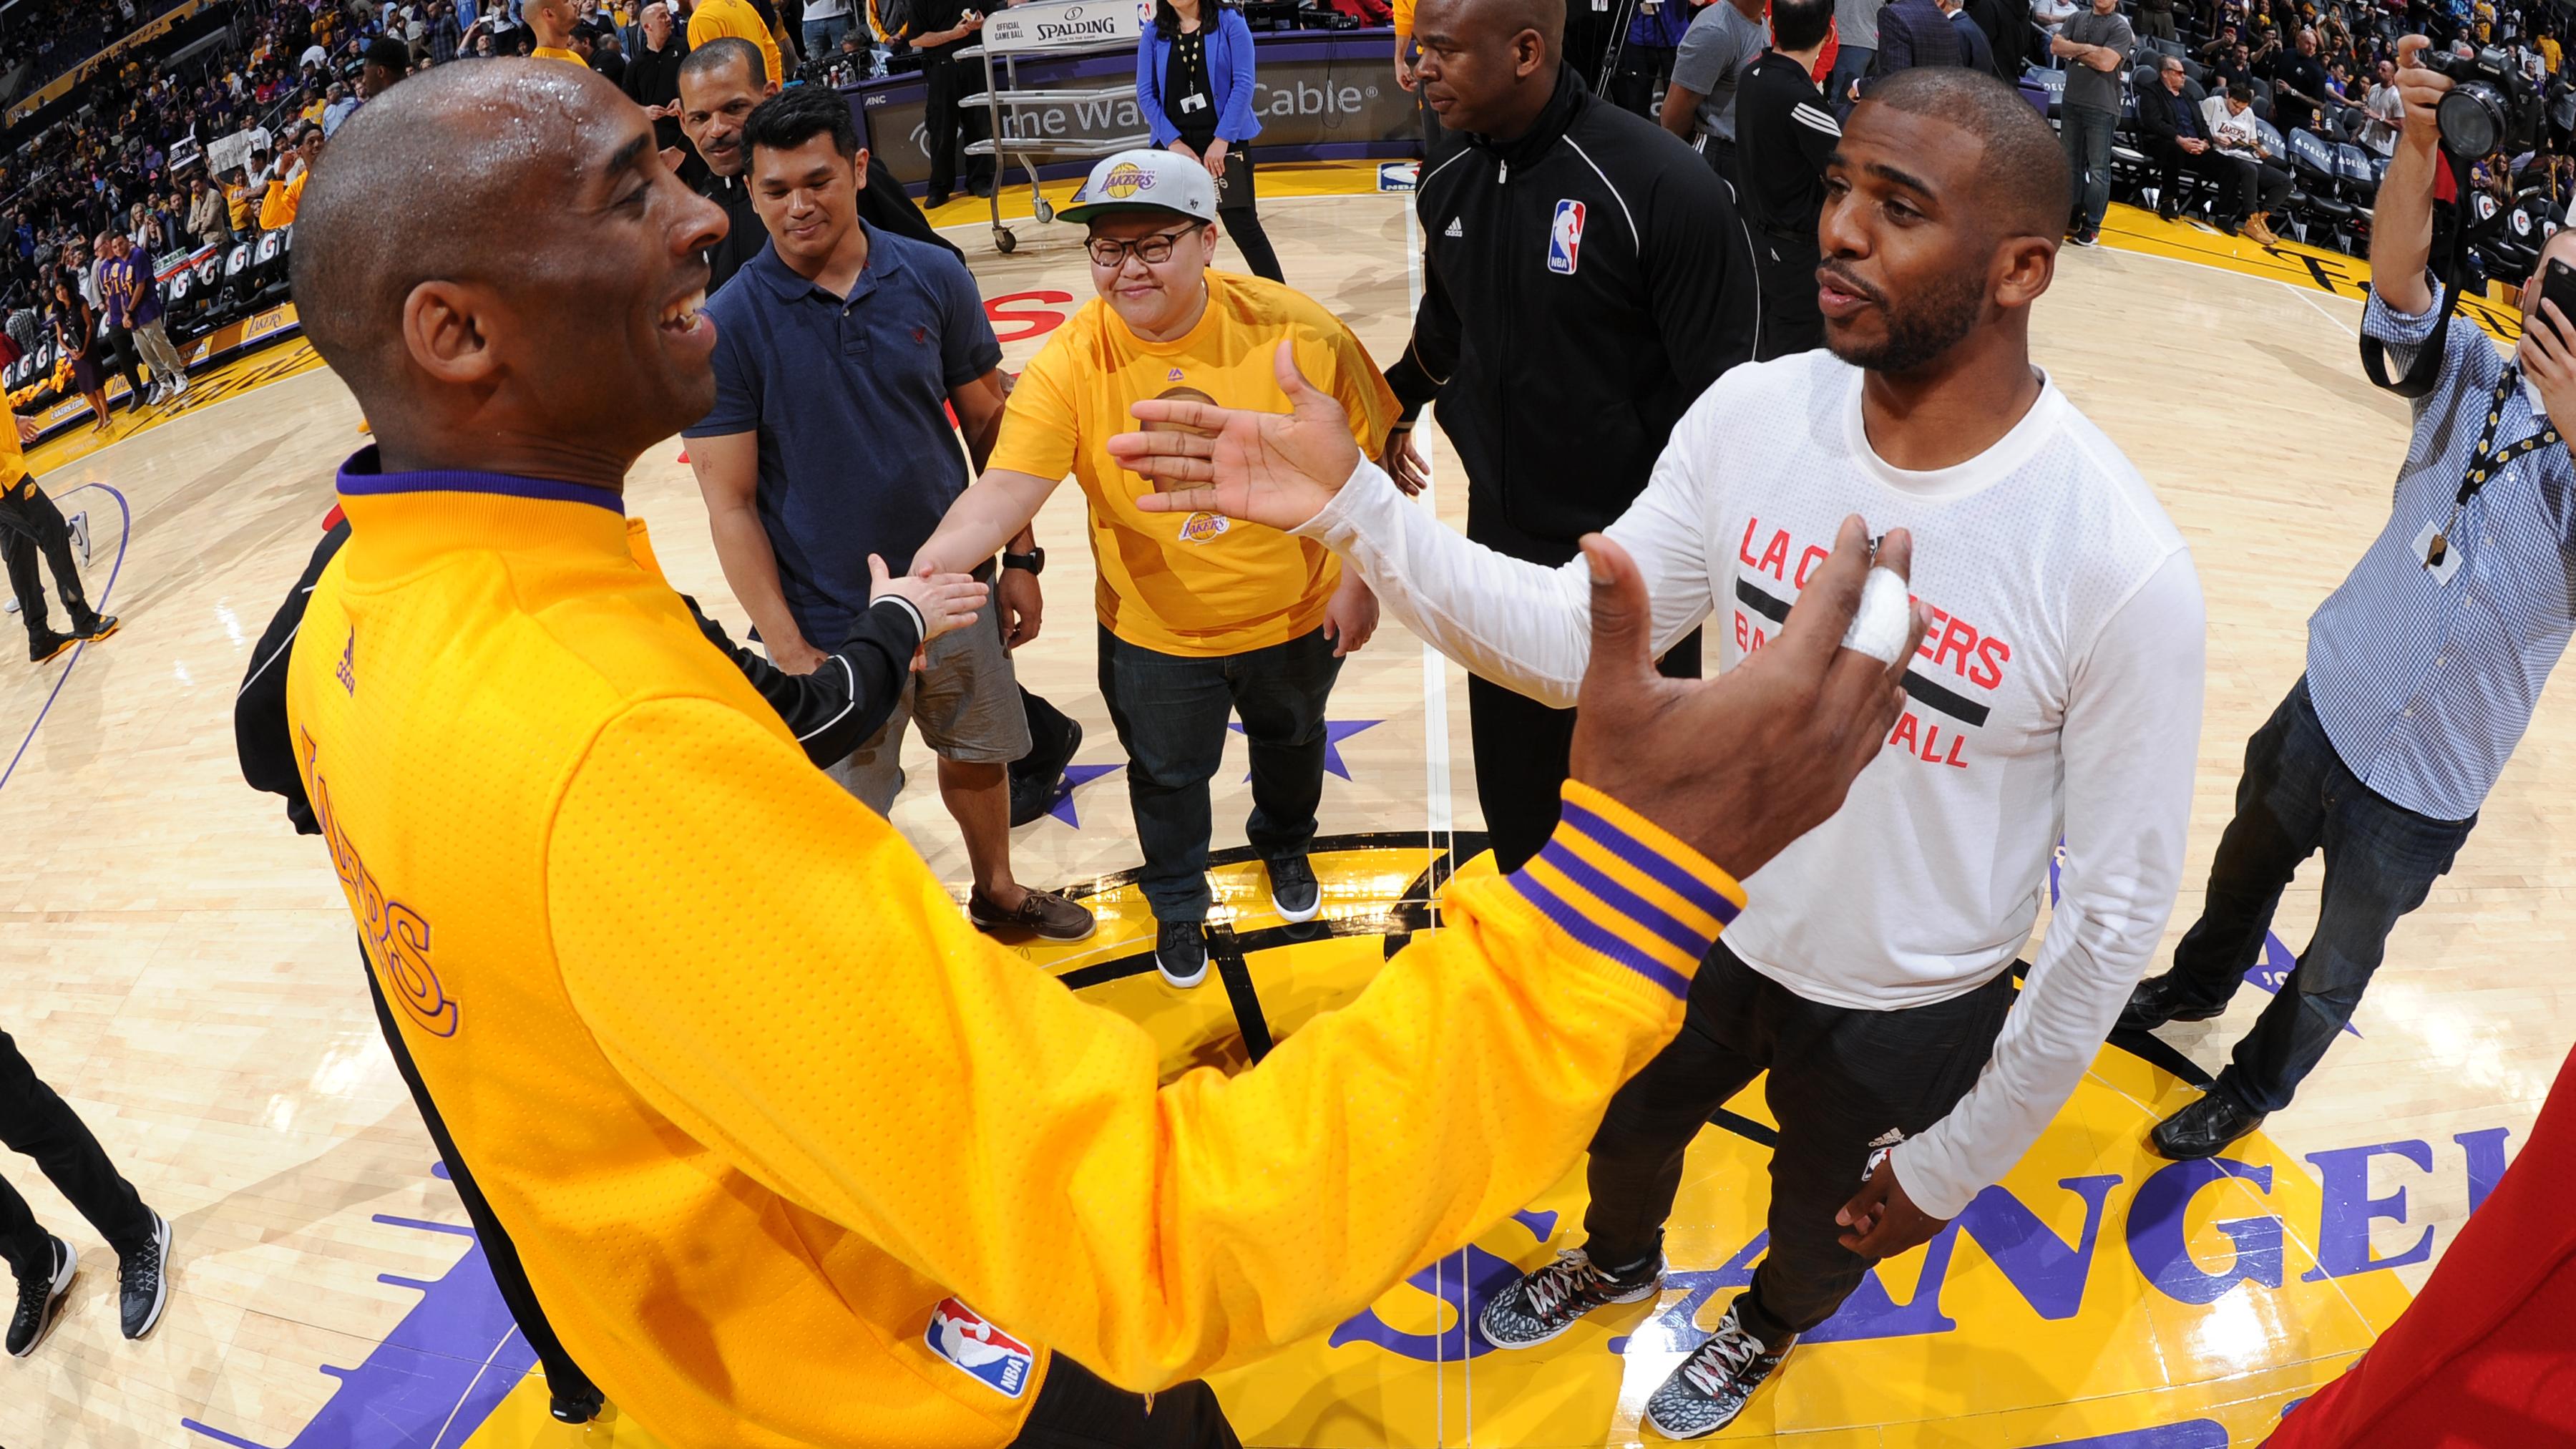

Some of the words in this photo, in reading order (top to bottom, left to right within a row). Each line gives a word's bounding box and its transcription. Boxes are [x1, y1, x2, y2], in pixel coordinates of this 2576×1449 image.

[997, 21, 1020, 31] OFFICIAL
[1011, 29, 1023, 39] BALL
[1038, 17, 1115, 41] SPALDING
[865, 94, 887, 107] ANC
[2218, 122, 2247, 139] LAKERS
[2258, 129, 2286, 150] DELTA
[2303, 142, 2332, 164] DELTA
[2346, 157, 2371, 171] DELTA
[1098, 173, 1157, 194] LAKERS
[1551, 256, 1568, 269] NBA
[247, 312, 283, 338] LAKERS
[1183, 518, 1229, 537] LAKERS
[1740, 517, 1790, 582] LA
[1000, 1357, 1025, 1391] NBA
